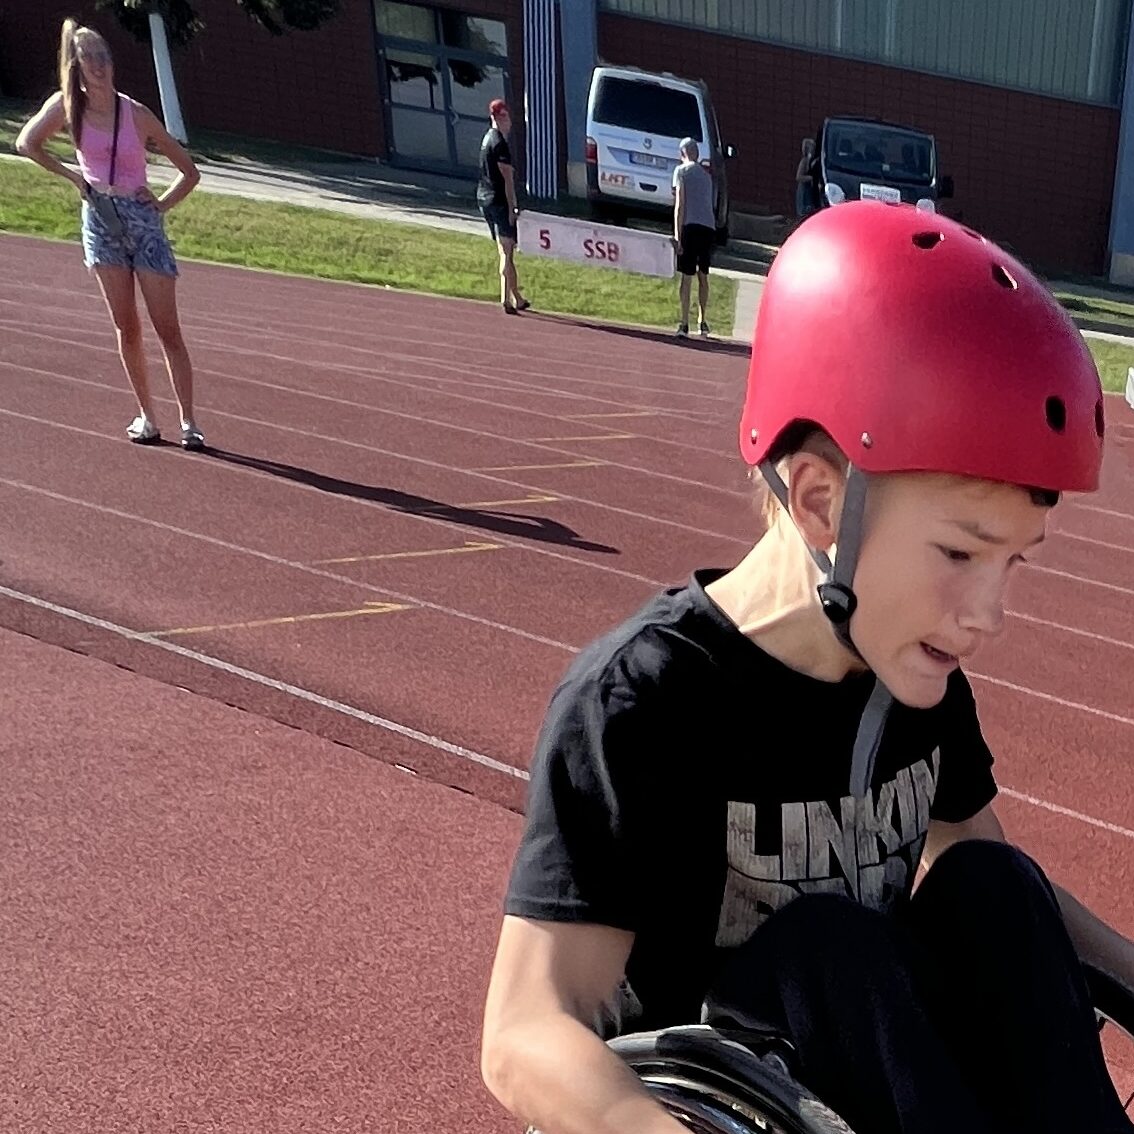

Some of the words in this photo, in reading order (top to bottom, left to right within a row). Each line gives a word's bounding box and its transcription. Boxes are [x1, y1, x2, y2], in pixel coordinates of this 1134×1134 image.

[539, 229, 551, 250] 5
[583, 239, 620, 262] SSB
[727, 745, 940, 901] LINKIN
